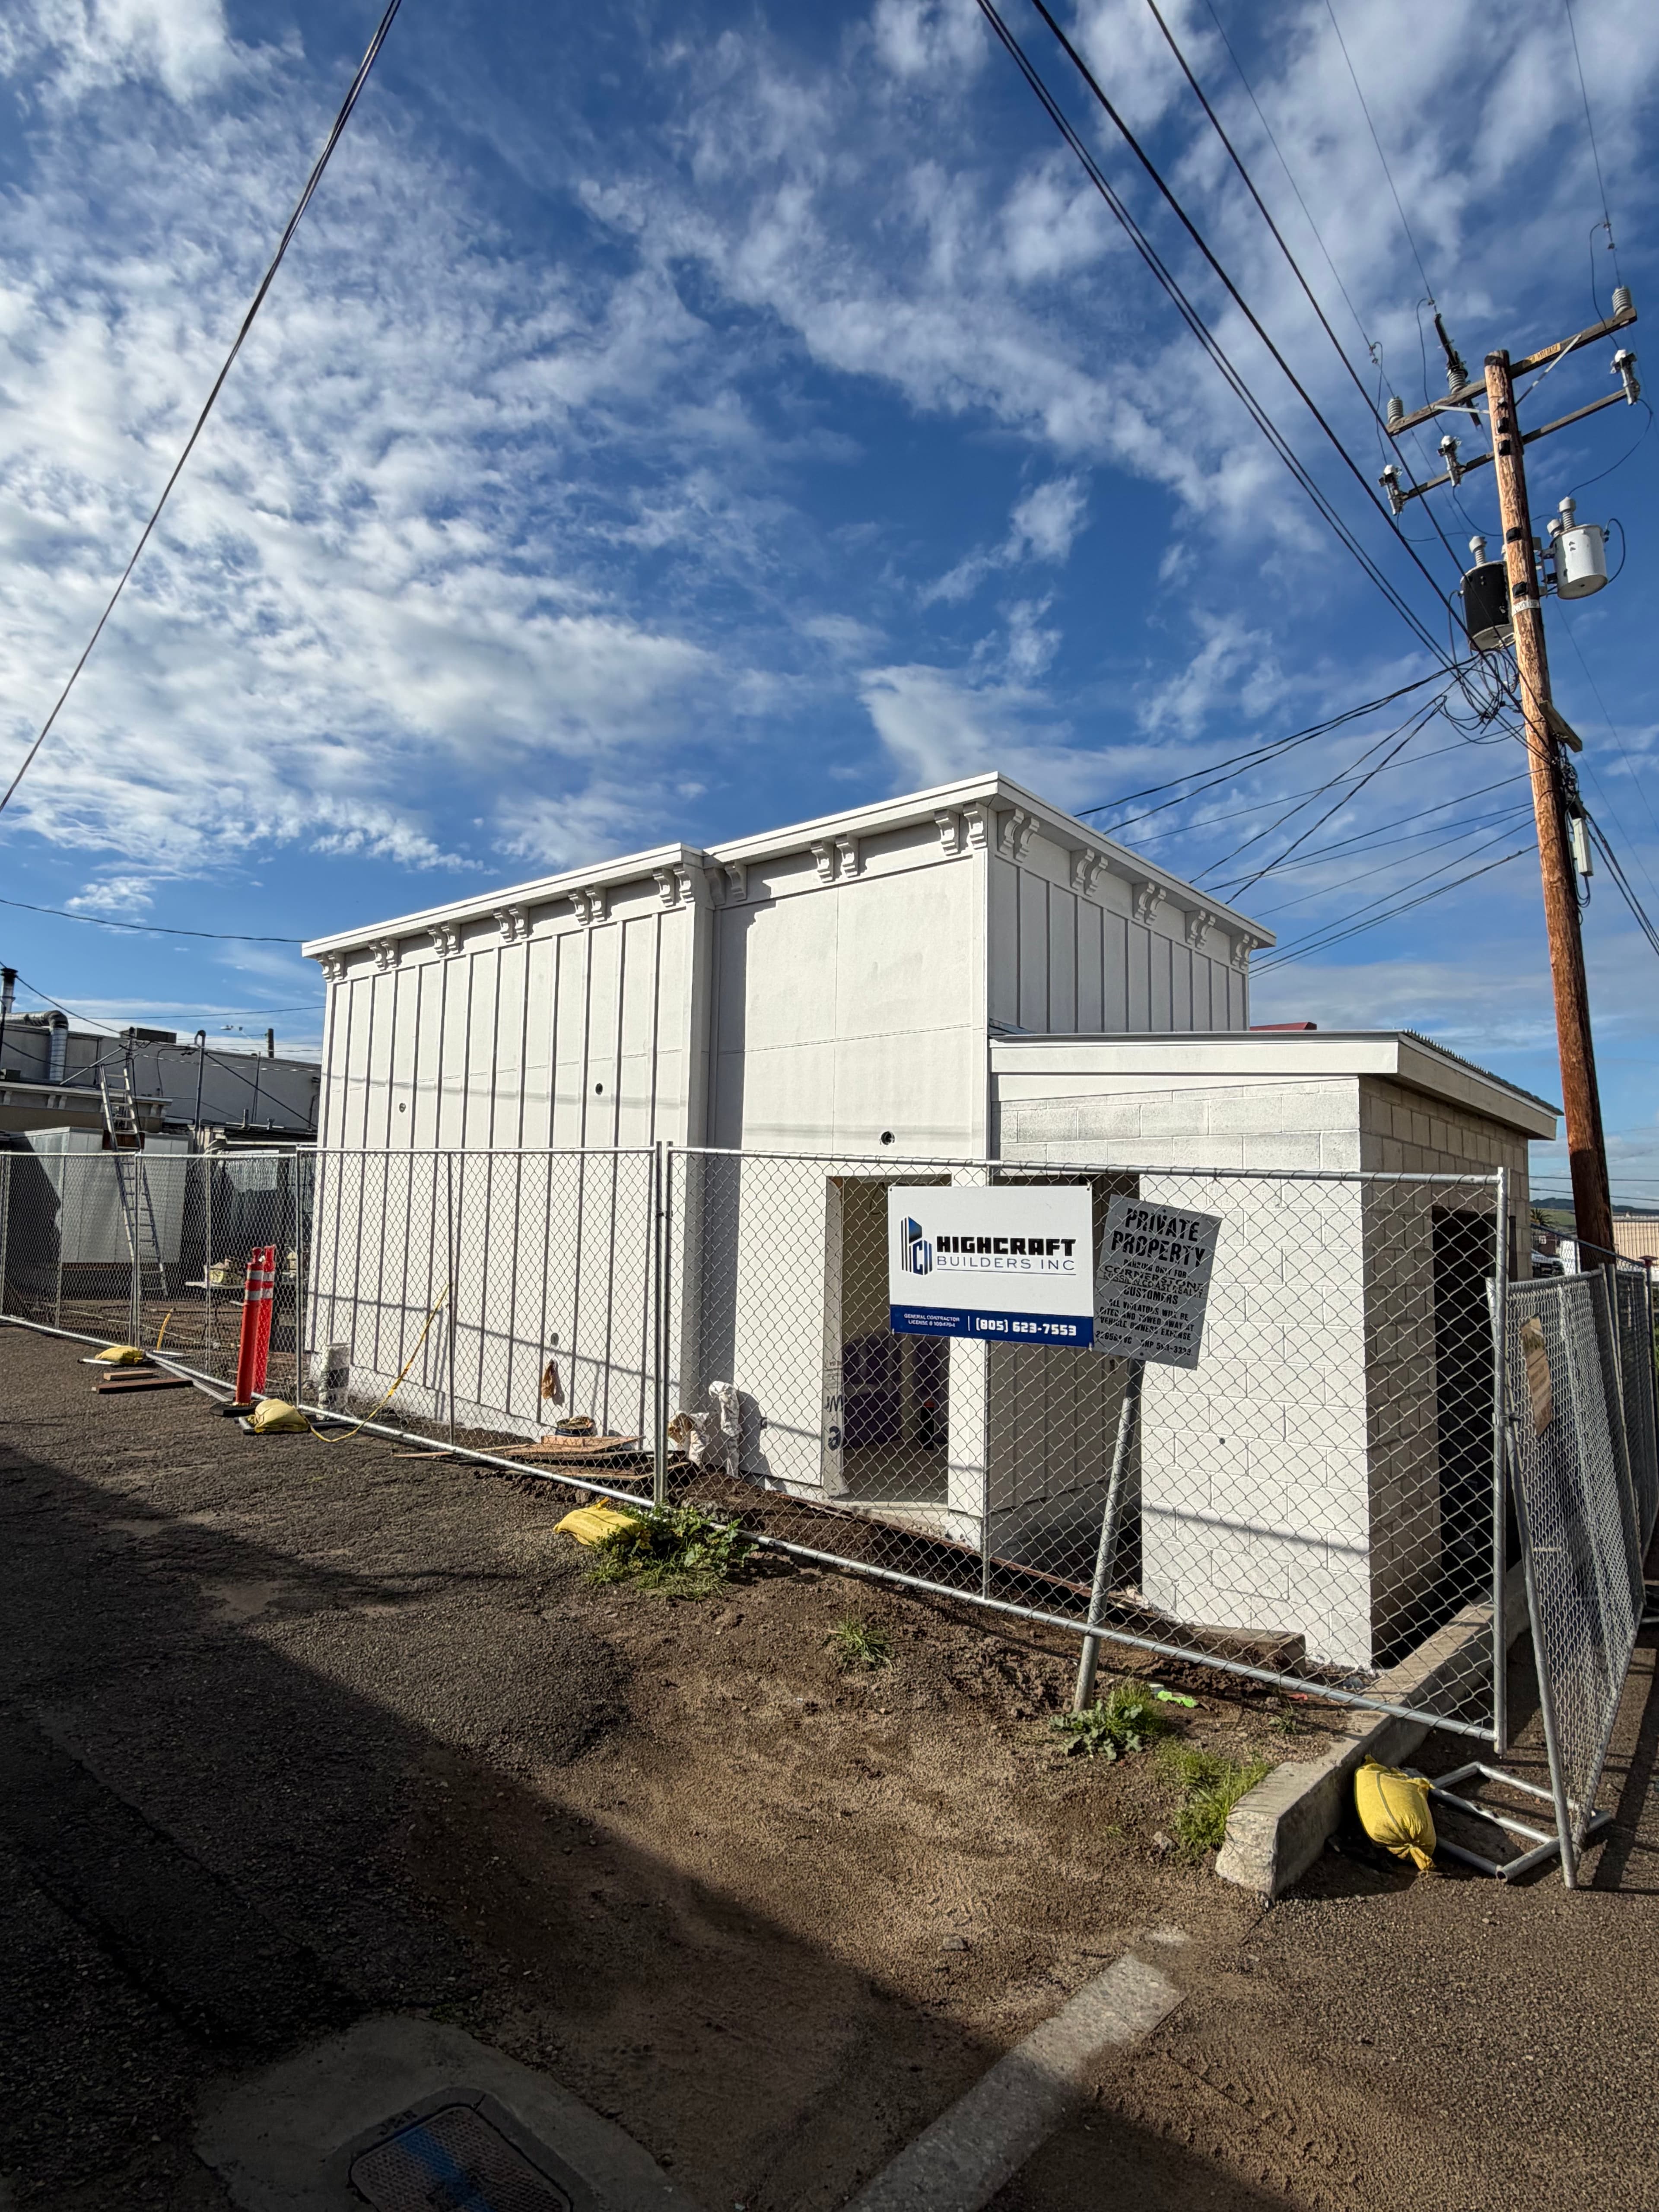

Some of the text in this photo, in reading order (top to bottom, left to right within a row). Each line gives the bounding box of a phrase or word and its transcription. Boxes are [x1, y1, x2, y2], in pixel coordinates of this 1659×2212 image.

[1125, 1208, 1200, 1242] PRIVATE
[937, 1236, 1076, 1256] HIGHCRAFT
[1111, 1230, 1205, 1268] PROPERTY
[937, 1256, 1075, 1271] BUILDERS INC
[1105, 1265, 1204, 1291] CORNERSTONE
[1174, 1269, 1187, 1278] FOR
[1142, 1279, 1170, 1292] COAST
[1123, 1286, 1179, 1305] CUSTOMERS
[976, 1318, 1077, 1336] (805) 623-7553
[1100, 1316, 1127, 1328] VEHICLE
[1161, 1328, 1191, 1340] EXPENSE
[1139, 1314, 1161, 1325] TOWED
[1164, 1320, 1183, 1329] AWAY
